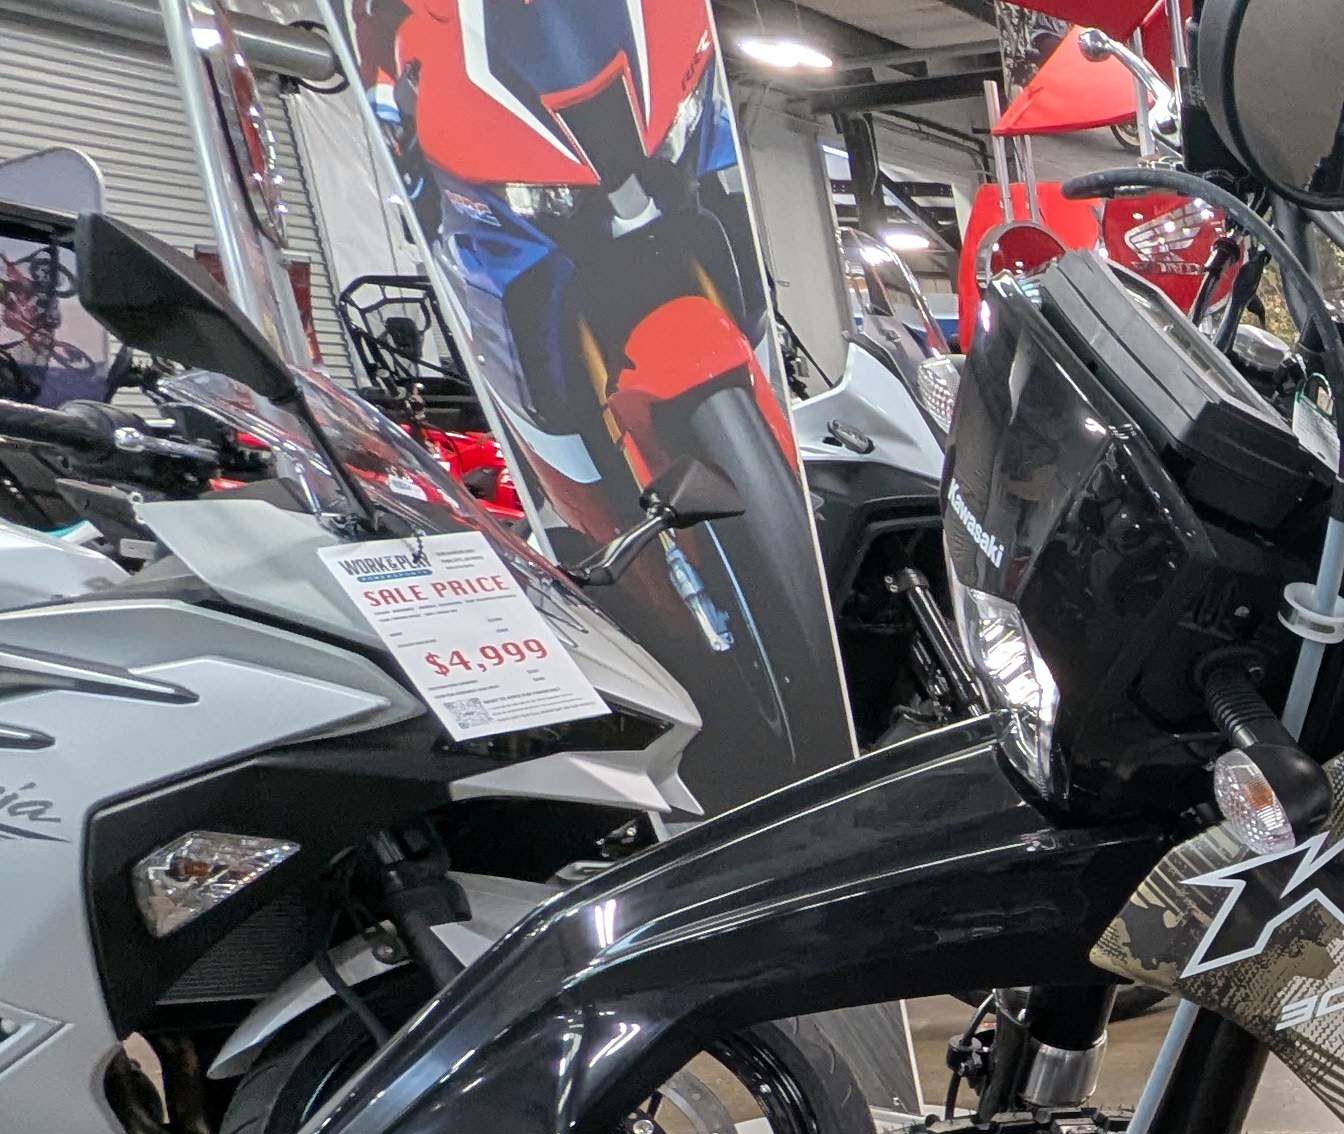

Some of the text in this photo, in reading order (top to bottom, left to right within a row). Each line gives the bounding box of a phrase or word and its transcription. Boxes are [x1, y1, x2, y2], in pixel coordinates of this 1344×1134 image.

[947, 477, 1006, 568] Kawasaki
[363, 575, 510, 607] SALE PRICE
[424, 638, 549, 677] $4,999
